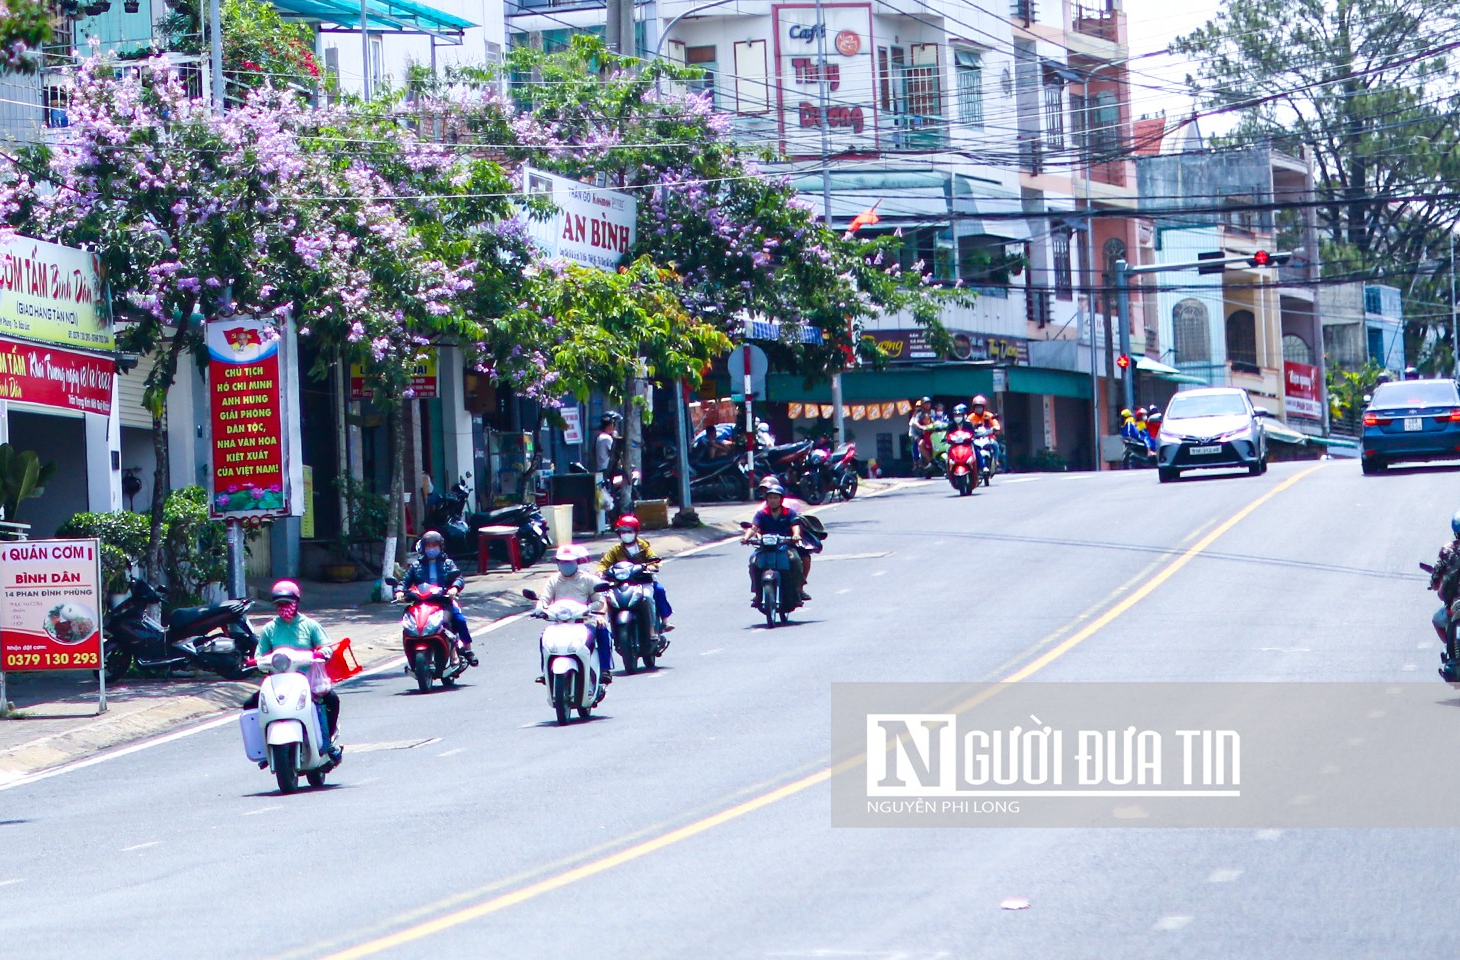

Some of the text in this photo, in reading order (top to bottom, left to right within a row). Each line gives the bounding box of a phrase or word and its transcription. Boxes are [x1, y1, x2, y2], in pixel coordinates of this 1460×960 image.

[562, 211, 630, 253] AN BÌNH
[25, 245, 48, 299] TẤM
[8, 345, 26, 376] TẤM
[225, 366, 263, 378] CHỦ TỊCH
[249, 380, 272, 390] MINH
[222, 397, 241, 406] ANH
[220, 409, 238, 420] GIẢI
[247, 422, 266, 433] TỘC,
[226, 449, 269, 463] KIỆT XUẤT
[217, 464, 279, 477] CỦA VIỆT NAM!
[9, 544, 84, 560] QUÁN CƠM
[15, 571, 81, 584] BÌNH DÂN
[7, 653, 98, 666] 0379 130 293
